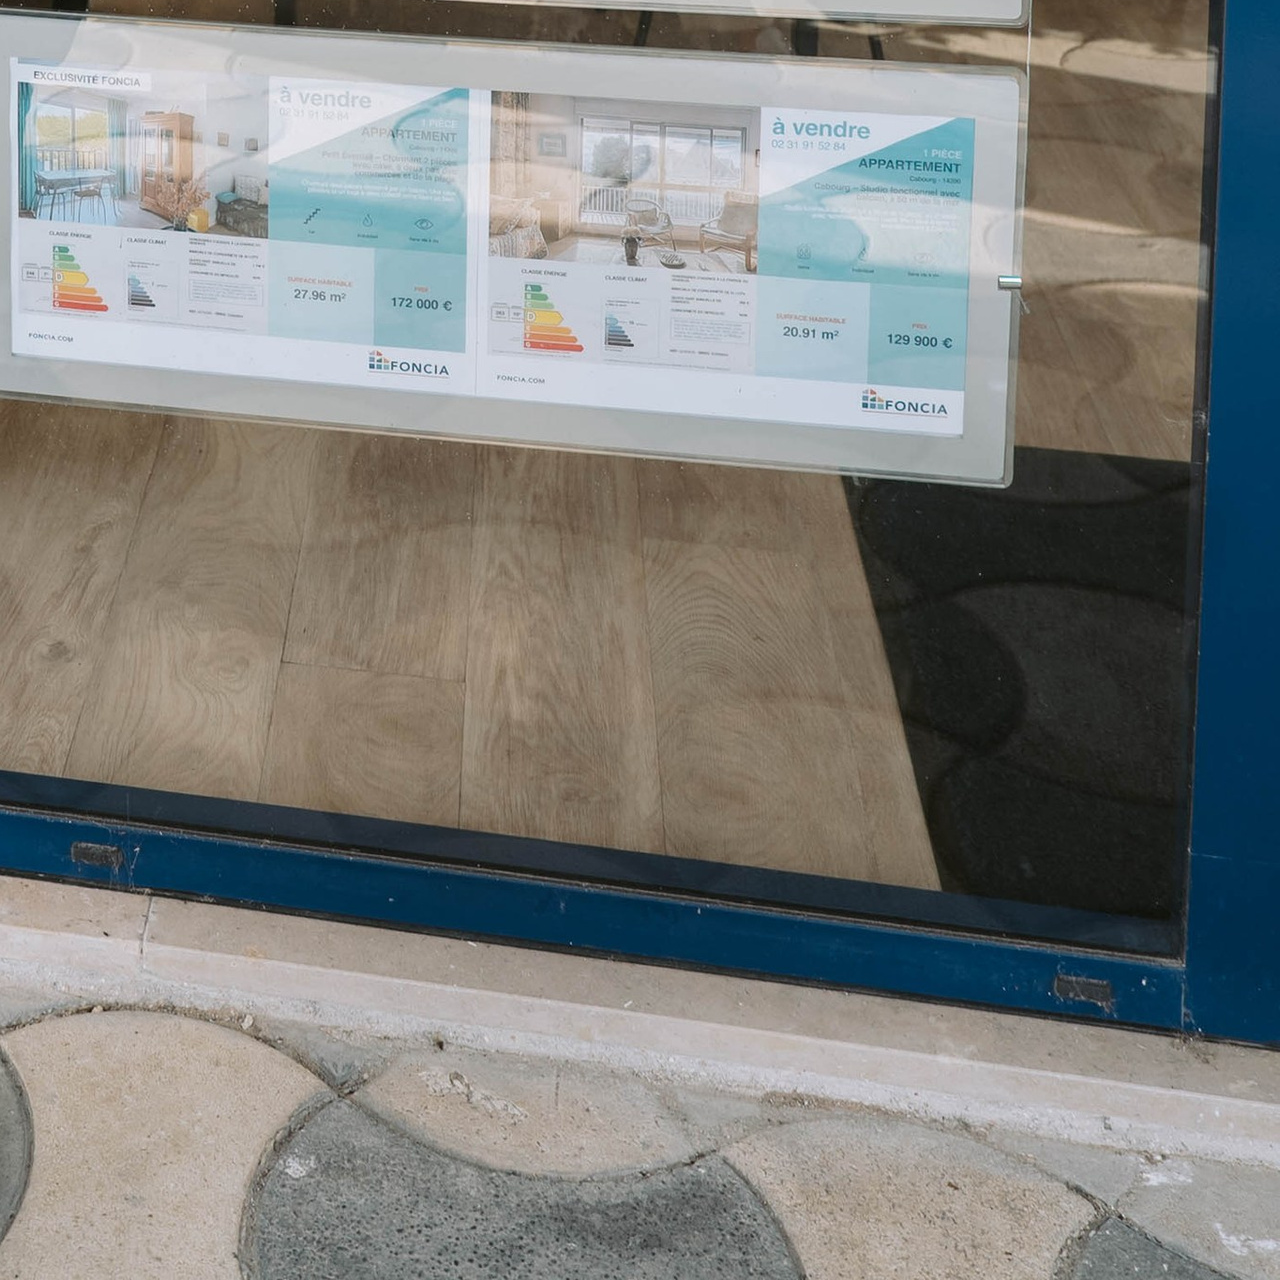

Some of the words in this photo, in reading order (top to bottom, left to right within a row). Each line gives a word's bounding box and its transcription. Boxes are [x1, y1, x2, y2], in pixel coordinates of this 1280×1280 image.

[33, 71, 98, 84] EXCLUSIVITÉ
[102, 76, 140, 87] FONCIA
[280, 86, 291, 104] à
[299, 91, 372, 108] vendre
[361, 127, 457, 143] APPARTEMENT
[772, 117, 785, 135] à
[793, 121, 870, 139] vendre
[771, 140, 784, 149] 02
[788, 141, 798, 149] 31
[802, 141, 814, 150] 91
[818, 142, 830, 151] 52
[833, 142, 845, 151] 84
[932, 148, 962, 159] PIÈCE
[858, 158, 962, 173] APPARTEMENT
[294, 289, 326, 301] 27.96
[330, 293, 346, 303] m²
[391, 298, 412, 308] 172
[416, 299, 438, 310] 000
[443, 301, 452, 311] €
[783, 326, 816, 339] 20.91
[822, 330, 839, 340] m²
[887, 334, 910, 345] 129
[914, 336, 938, 347] 900
[942, 338, 953, 348] €
[391, 361, 449, 375] FONCIA
[885, 400, 947, 414] FONCIA
